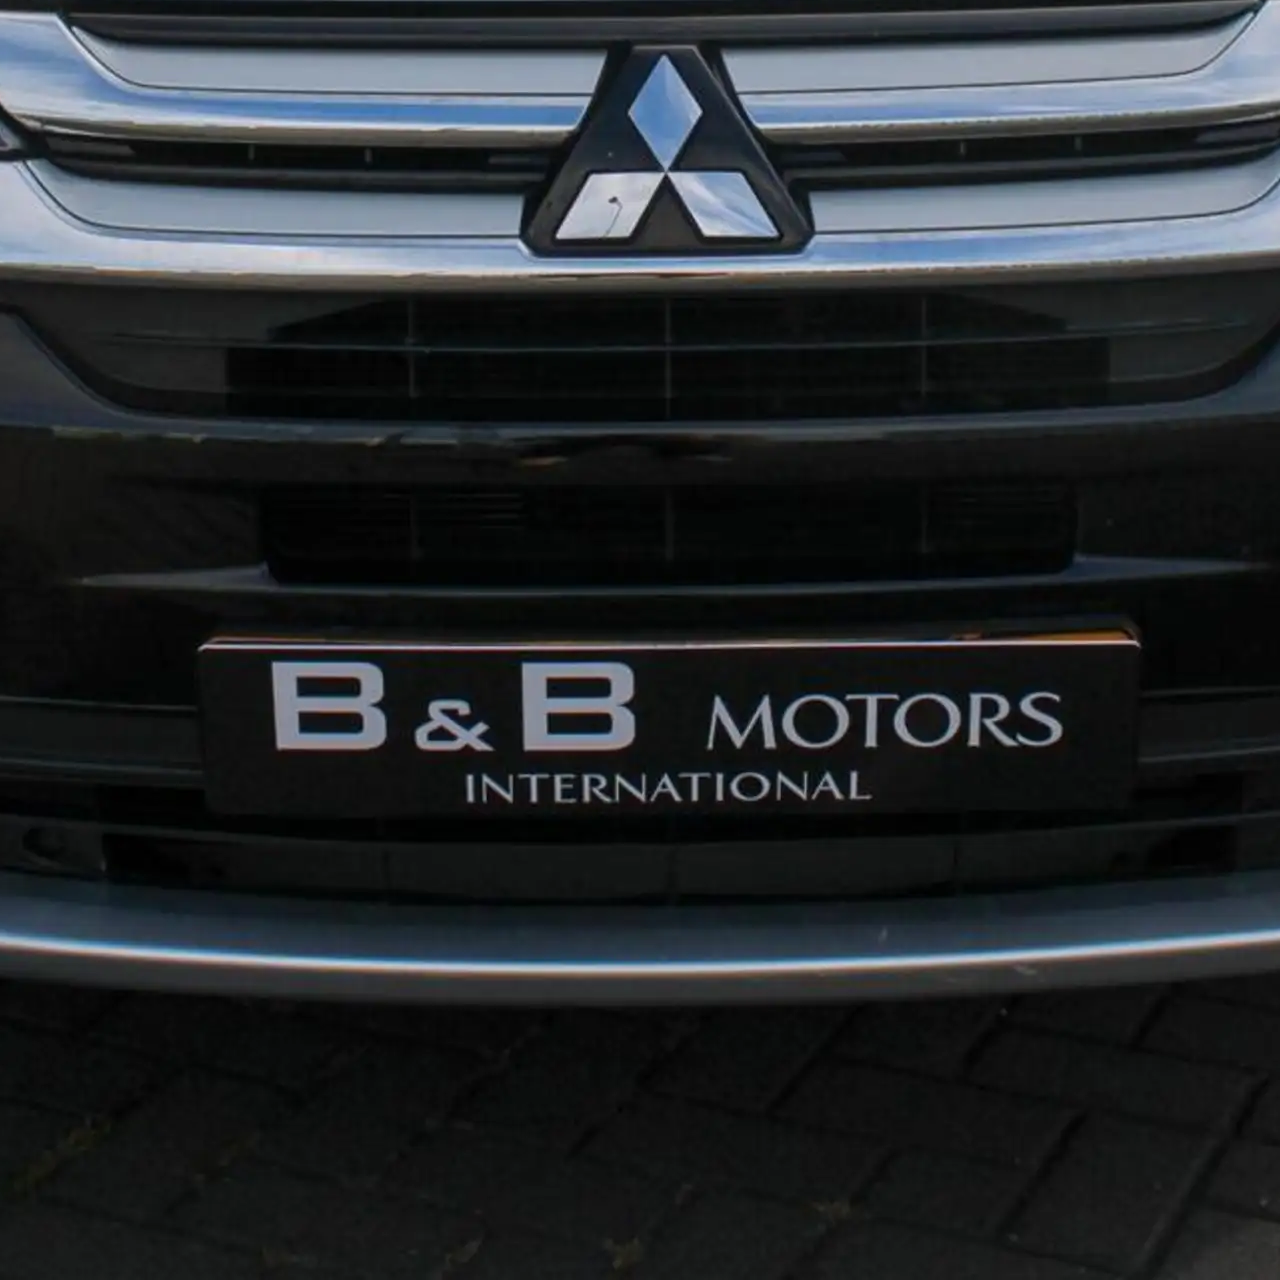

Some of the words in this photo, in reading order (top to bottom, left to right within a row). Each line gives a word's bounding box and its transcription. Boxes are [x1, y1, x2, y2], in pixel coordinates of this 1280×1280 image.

[270, 660, 388, 752] B
[413, 698, 495, 752] &
[521, 660, 637, 752] B
[706, 692, 1064, 751] MOTORS
[464, 770, 873, 805] INTERNATIONAL
